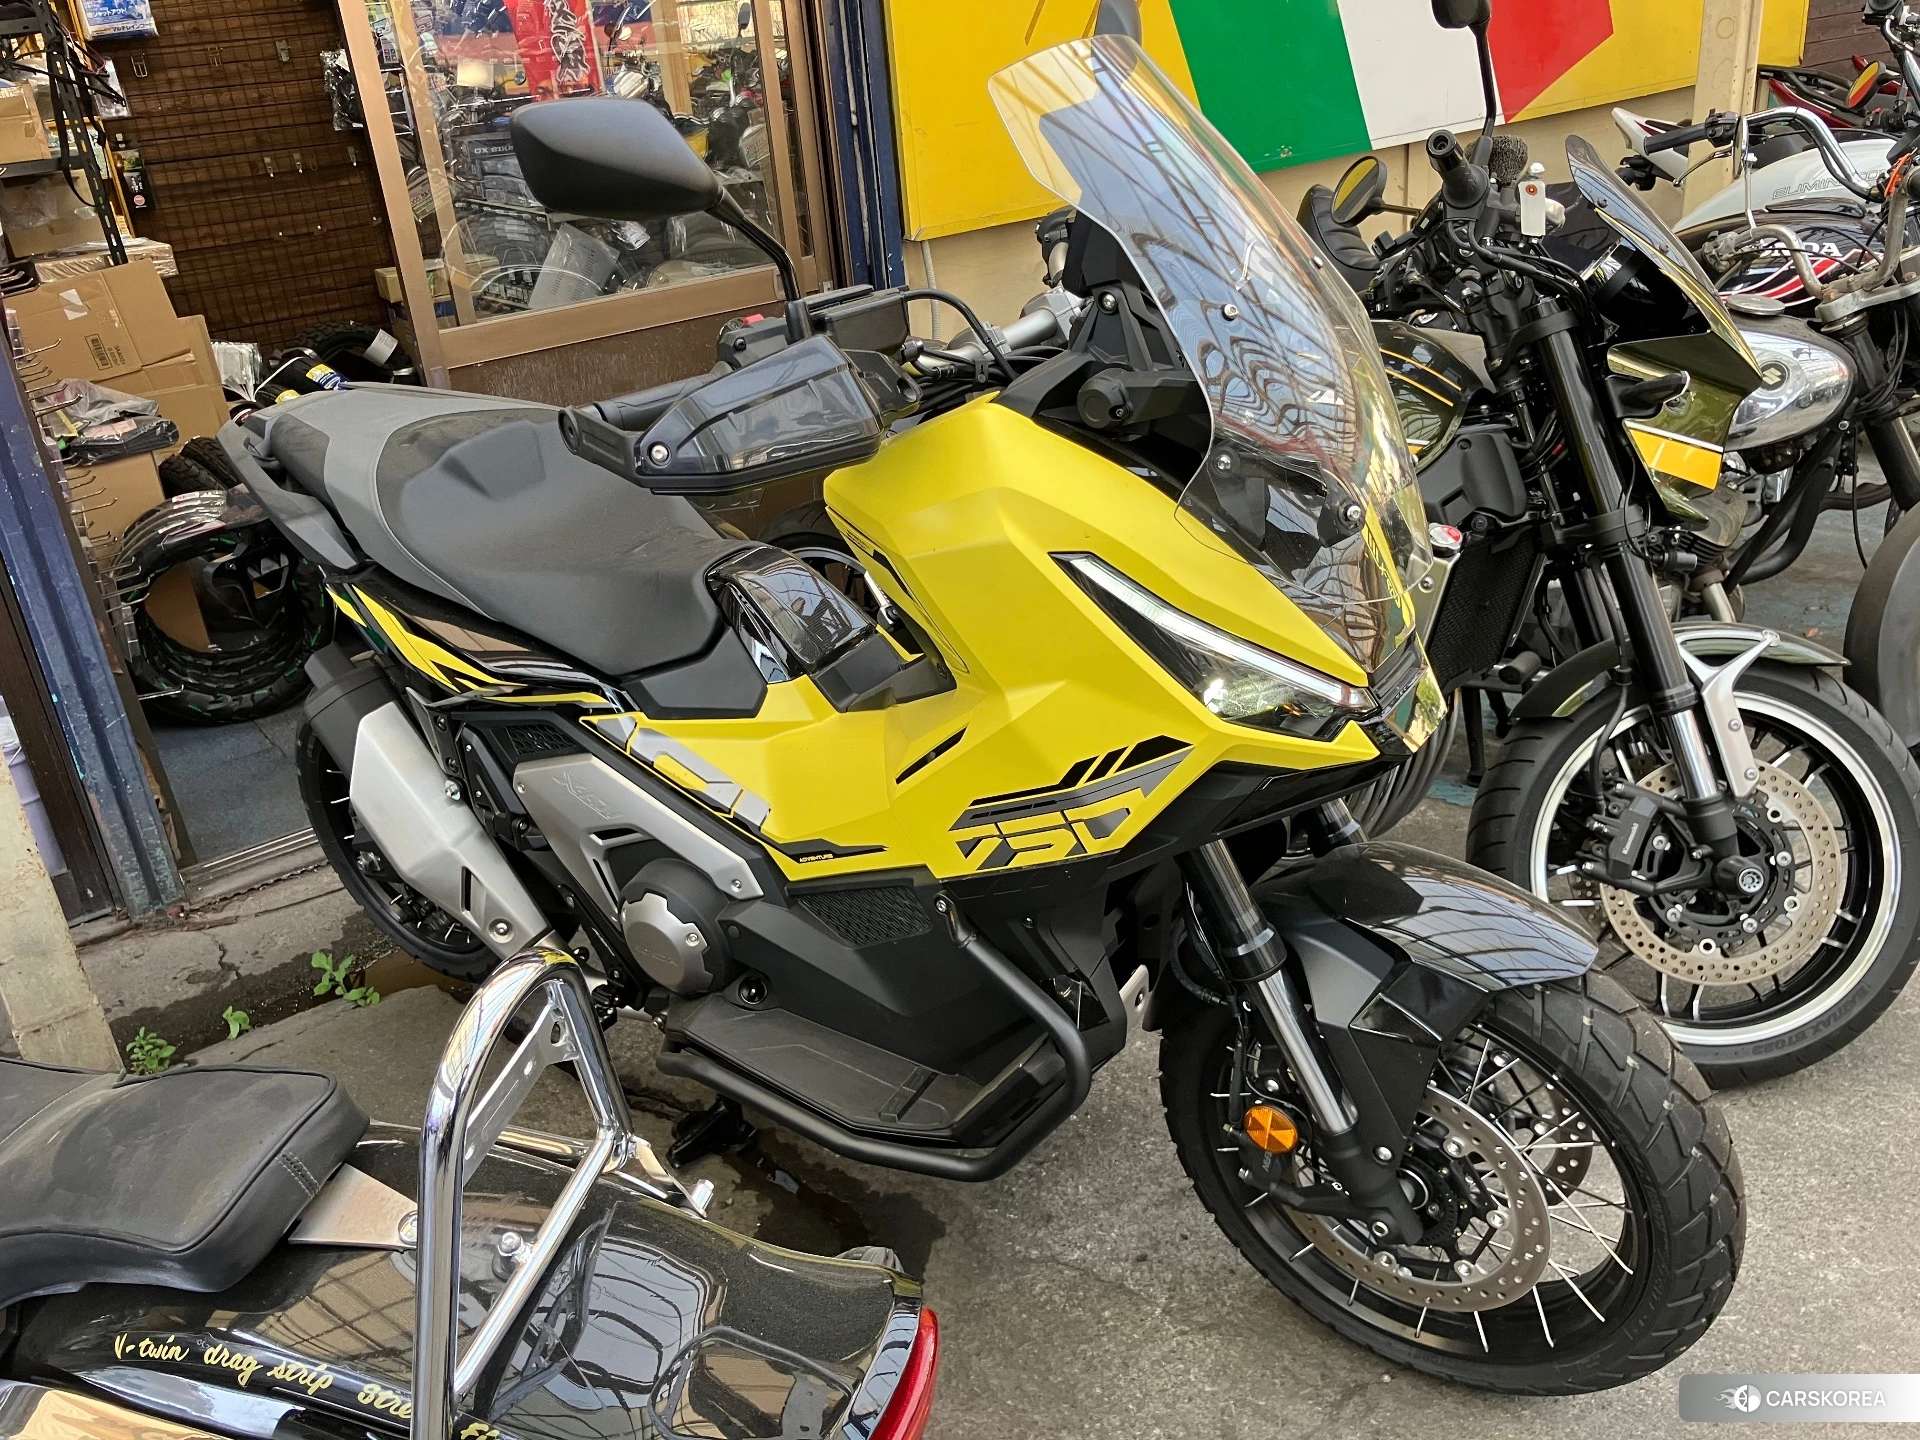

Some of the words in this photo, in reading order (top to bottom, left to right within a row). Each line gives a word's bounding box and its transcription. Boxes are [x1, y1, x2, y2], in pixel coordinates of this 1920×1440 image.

[114, 1333, 190, 1361] V-twin
[204, 1343, 263, 1387] drag
[267, 1361, 333, 1395] strip
